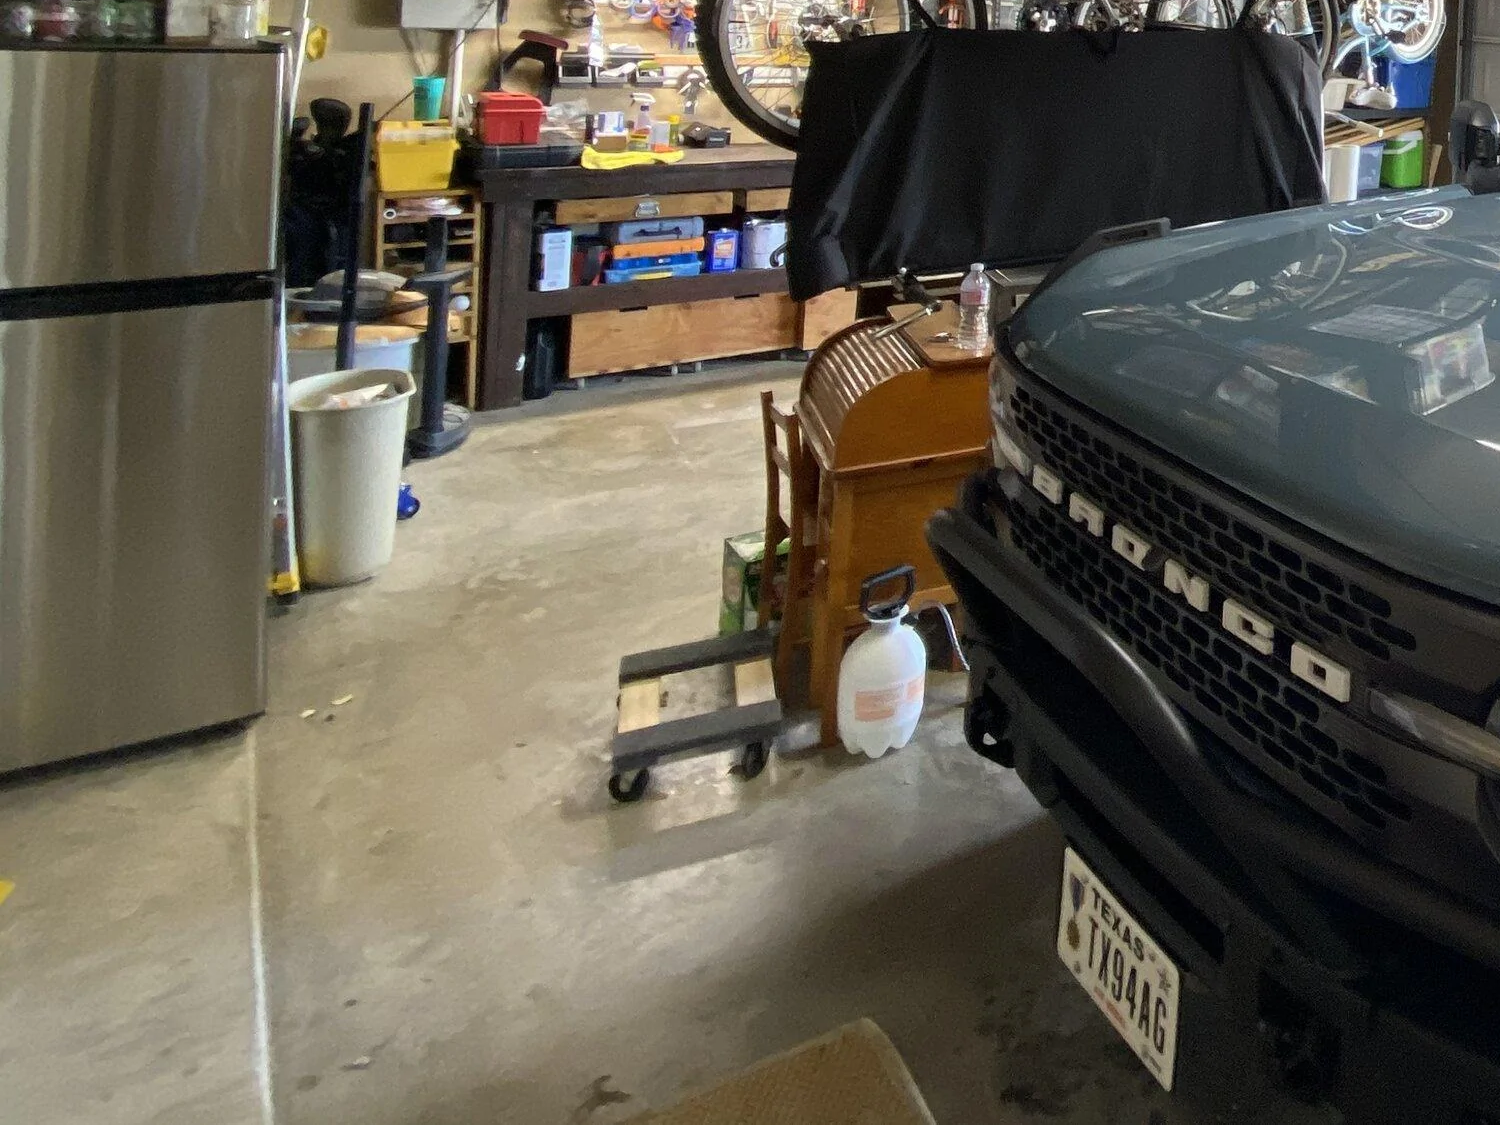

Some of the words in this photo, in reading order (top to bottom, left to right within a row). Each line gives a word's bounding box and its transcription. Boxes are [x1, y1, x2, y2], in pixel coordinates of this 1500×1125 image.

[1033, 463, 1350, 703] BRONCO
[1088, 915, 1167, 1054] TX94AG
[1092, 887, 1144, 962] TEXAS
